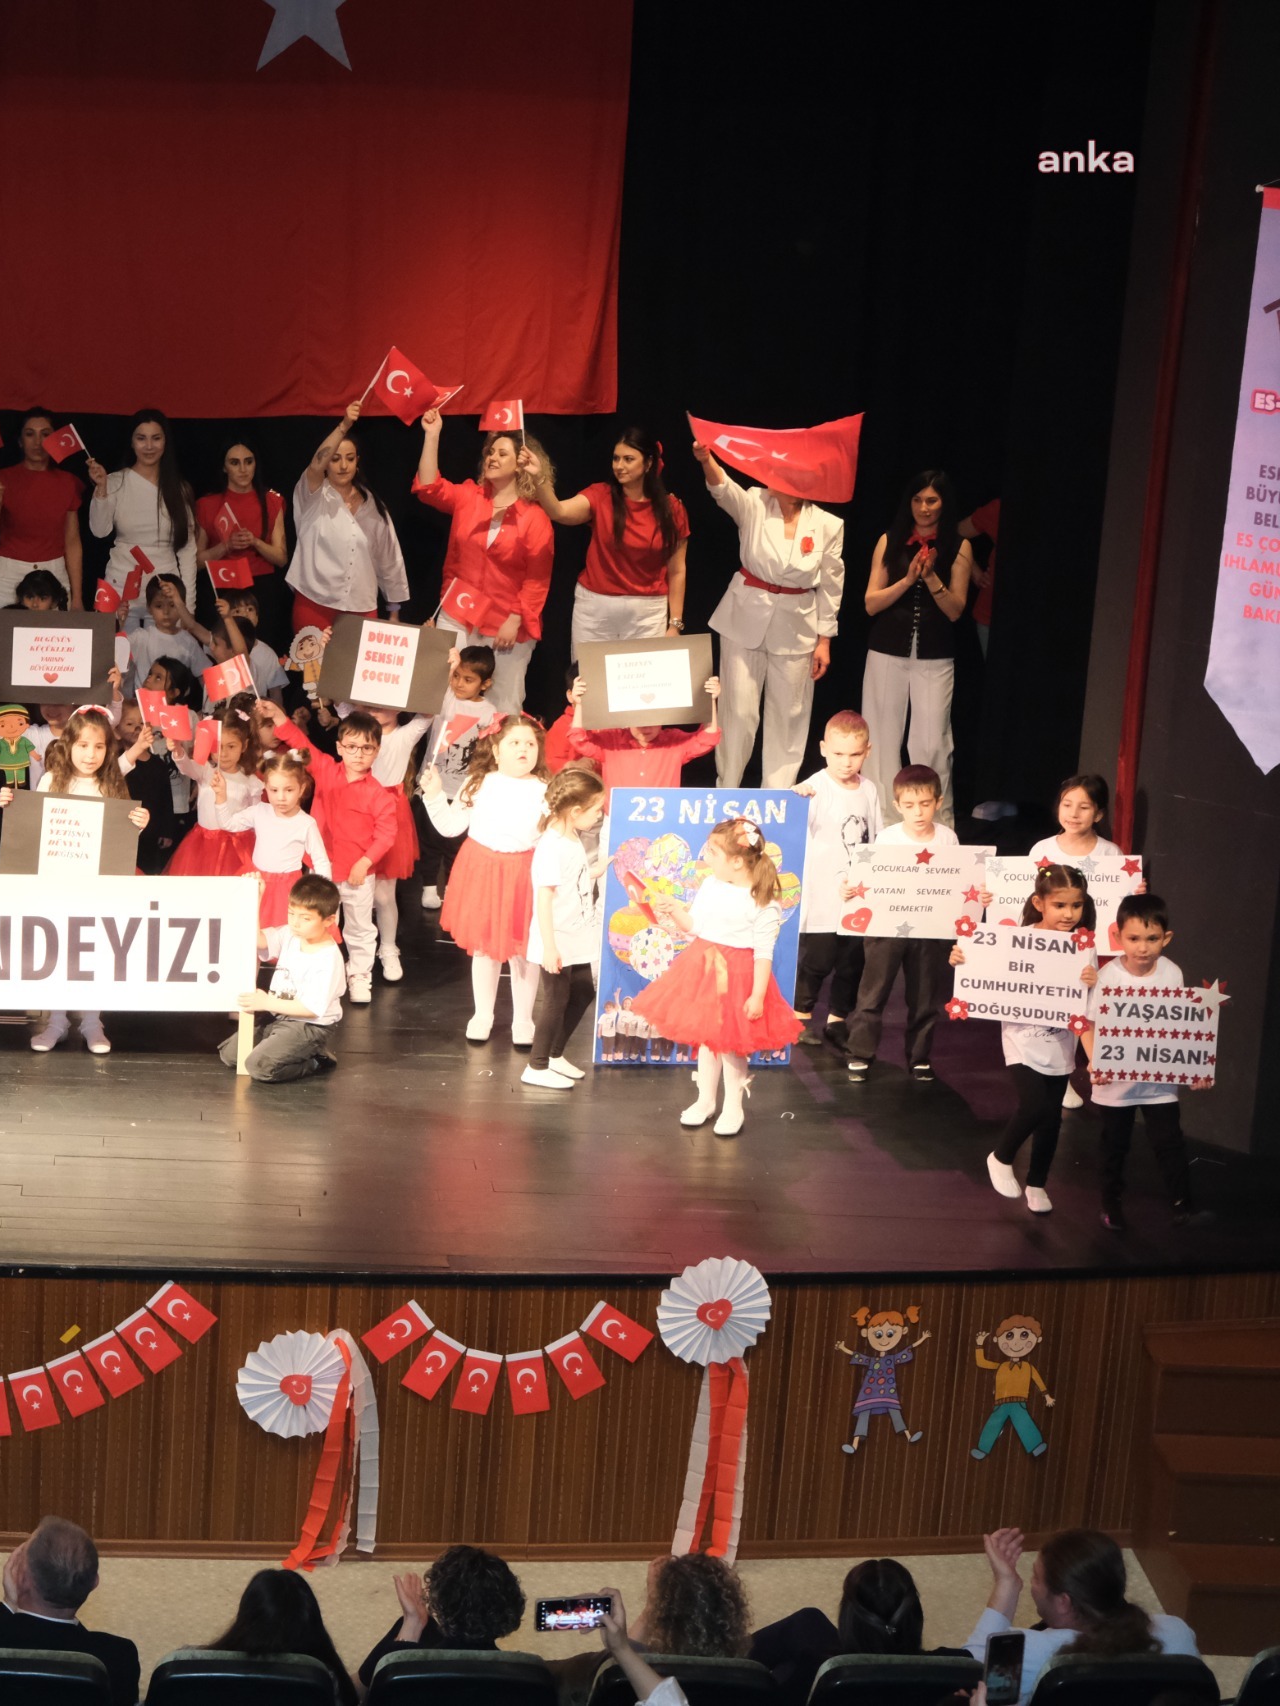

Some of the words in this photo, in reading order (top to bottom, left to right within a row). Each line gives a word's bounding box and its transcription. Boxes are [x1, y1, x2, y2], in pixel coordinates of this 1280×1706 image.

[1259, 464, 1280, 481] ES
[1236, 532, 1254, 548] ES
[367, 631, 409, 648] DÜNYA
[364, 650, 405, 667] SENSİN
[361, 669, 401, 685] ÇOCUK
[628, 796, 666, 823] 23
[678, 794, 787, 824] NİSAN
[871, 864, 920, 873] ÇOCUKLARI
[925, 867, 961, 875] SEVMEK
[1086, 873, 1121, 883] İLGİYLE
[873, 887, 906, 895] VATANI
[916, 888, 952, 896] SEVMEK
[889, 904, 933, 913] DEMEKTİR
[973, 931, 997, 946] 23
[1011, 933, 1077, 955] NİSAN
[1008, 960, 1035, 974] BİR
[960, 978, 1082, 999] CUMHURİYETİN
[967, 1002, 1072, 1023] DOĞUŞUDUR!
[1113, 1002, 1205, 1023] YAŞASIN
[1100, 1045, 1125, 1061] 23
[1136, 1044, 1209, 1066] NİSAN!
